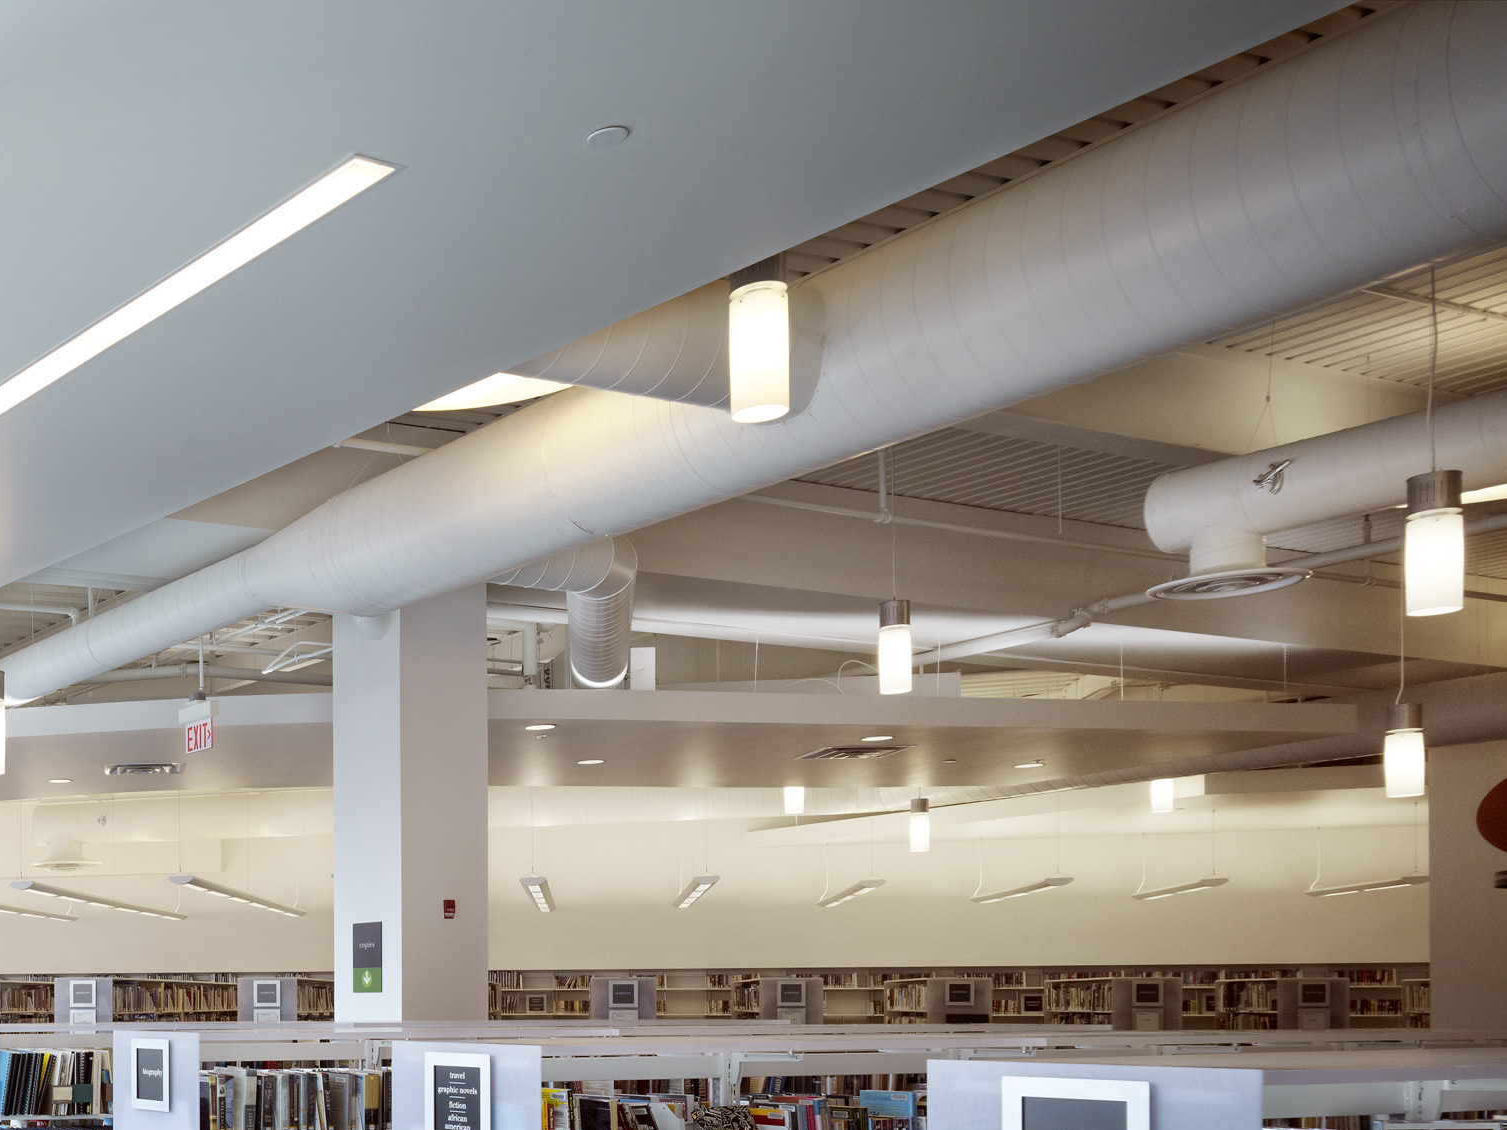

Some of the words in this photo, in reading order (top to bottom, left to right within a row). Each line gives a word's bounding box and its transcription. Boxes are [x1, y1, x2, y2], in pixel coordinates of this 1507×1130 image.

[187, 722, 208, 752] EXIT
[359, 941, 375, 949] copies
[142, 1068, 162, 1077] biography
[438, 1086, 458, 1094] graphic
[459, 1087, 478, 1095] novels
[449, 1101, 466, 1109] fiction
[448, 1114, 467, 1122] african
